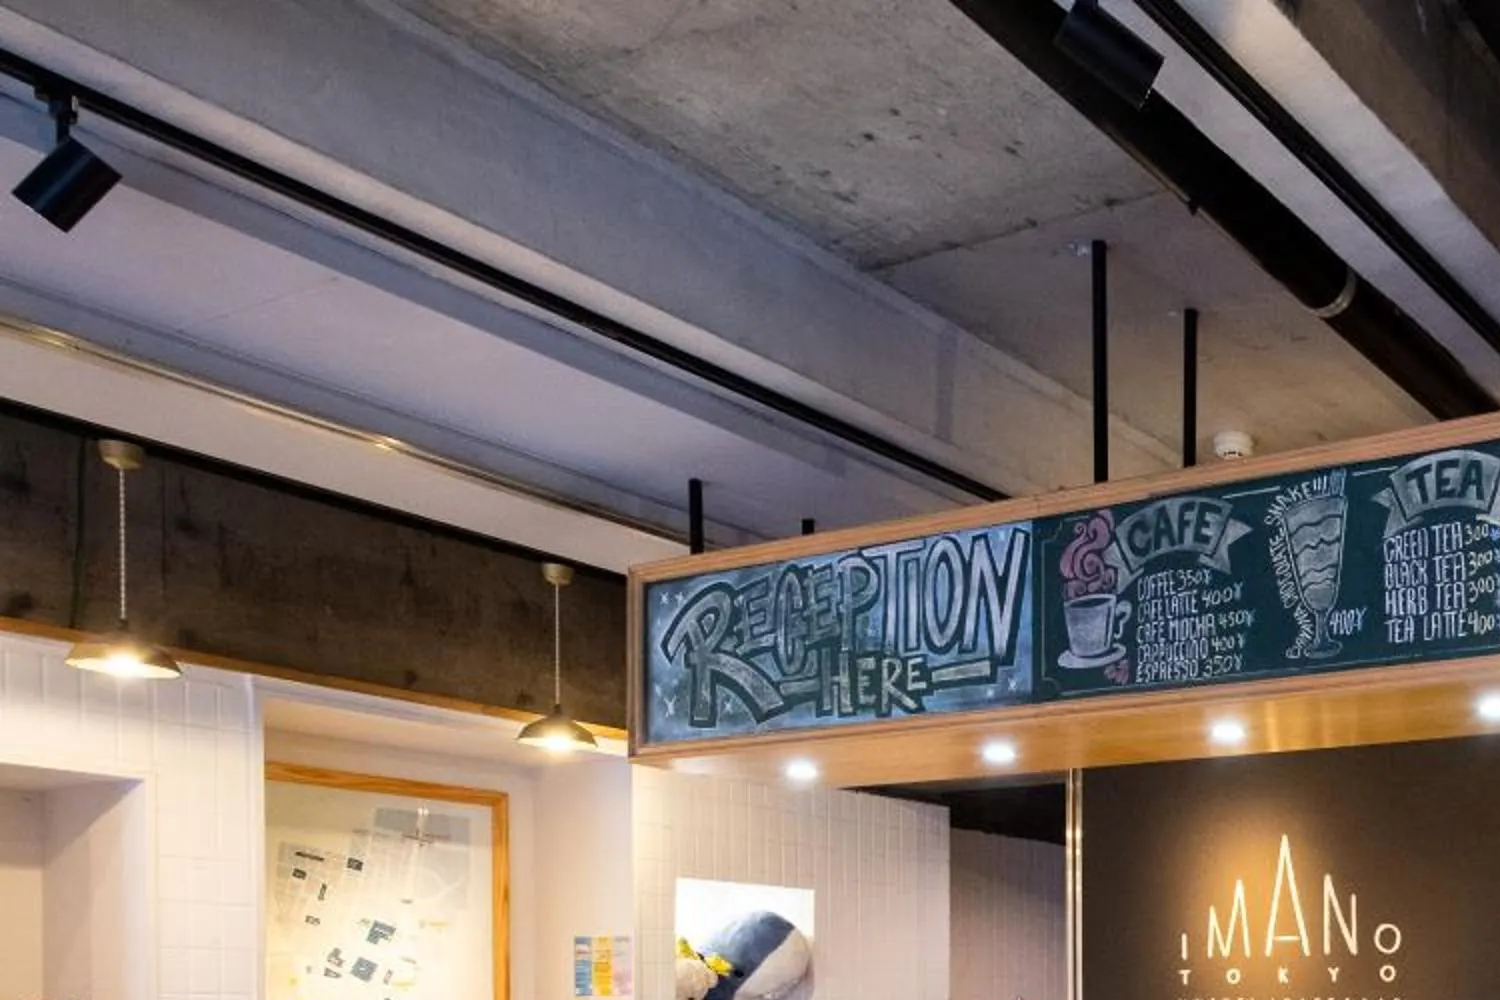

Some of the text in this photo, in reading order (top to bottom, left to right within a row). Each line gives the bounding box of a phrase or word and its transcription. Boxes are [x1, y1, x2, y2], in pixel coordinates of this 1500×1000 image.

[1405, 458, 1485, 505] TEA
[1127, 501, 1225, 553] CAFE
[1384, 528, 1428, 562] GREEN
[1431, 521, 1463, 553] TEA
[1138, 570, 1176, 601] COFFEE
[1385, 560, 1428, 589] BLACK
[1433, 552, 1466, 581] TEA
[1138, 600, 1163, 623] CAFE
[1165, 590, 1198, 619] LATTE
[1386, 586, 1428, 616] HERB
[1435, 582, 1468, 610] TEA
[660, 528, 1032, 728] RECEPTION
[1136, 621, 1165, 644] CAFE
[1169, 614, 1216, 641] MOCHA
[1384, 616, 1414, 644] TEA
[1424, 610, 1468, 641] LATTE
[1138, 637, 1208, 664] CAPPUCCINO
[815, 648, 928, 719] HERE
[1136, 659, 1199, 683] ESPRESSO
[1181, 833, 1402, 960] IMANO
[1178, 966, 1397, 985] TOKYO
